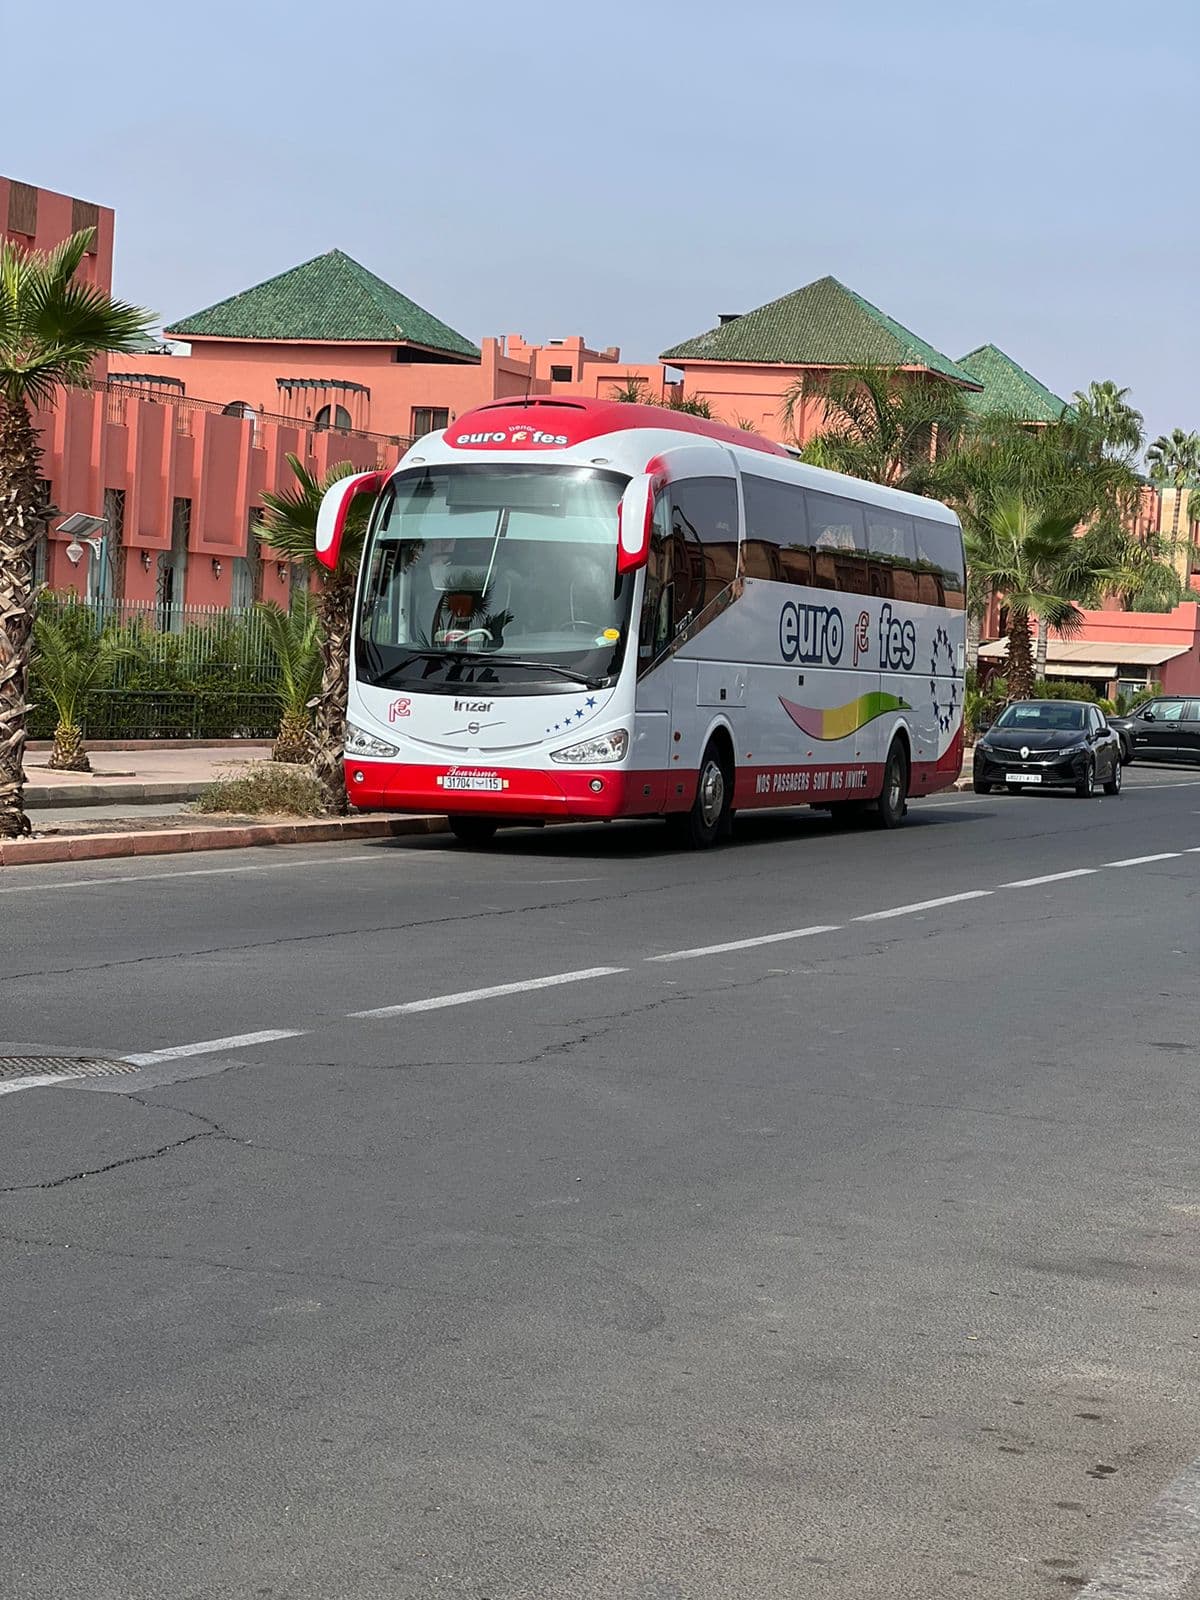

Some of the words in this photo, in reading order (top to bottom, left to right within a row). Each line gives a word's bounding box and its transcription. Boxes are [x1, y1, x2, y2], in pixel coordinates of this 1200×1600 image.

[457, 431, 506, 444] euro
[532, 431, 568, 444] fes
[780, 601, 844, 665] euro
[879, 603, 915, 670] fes
[446, 766, 498, 777] Tourisme
[447, 777, 471, 788] 31704
[488, 779, 499, 789] 15
[756, 774, 770, 793] NOS
[773, 772, 810, 792] PASSAGERS
[813, 771, 829, 789] SONT
[831, 771, 844, 789] NOS
